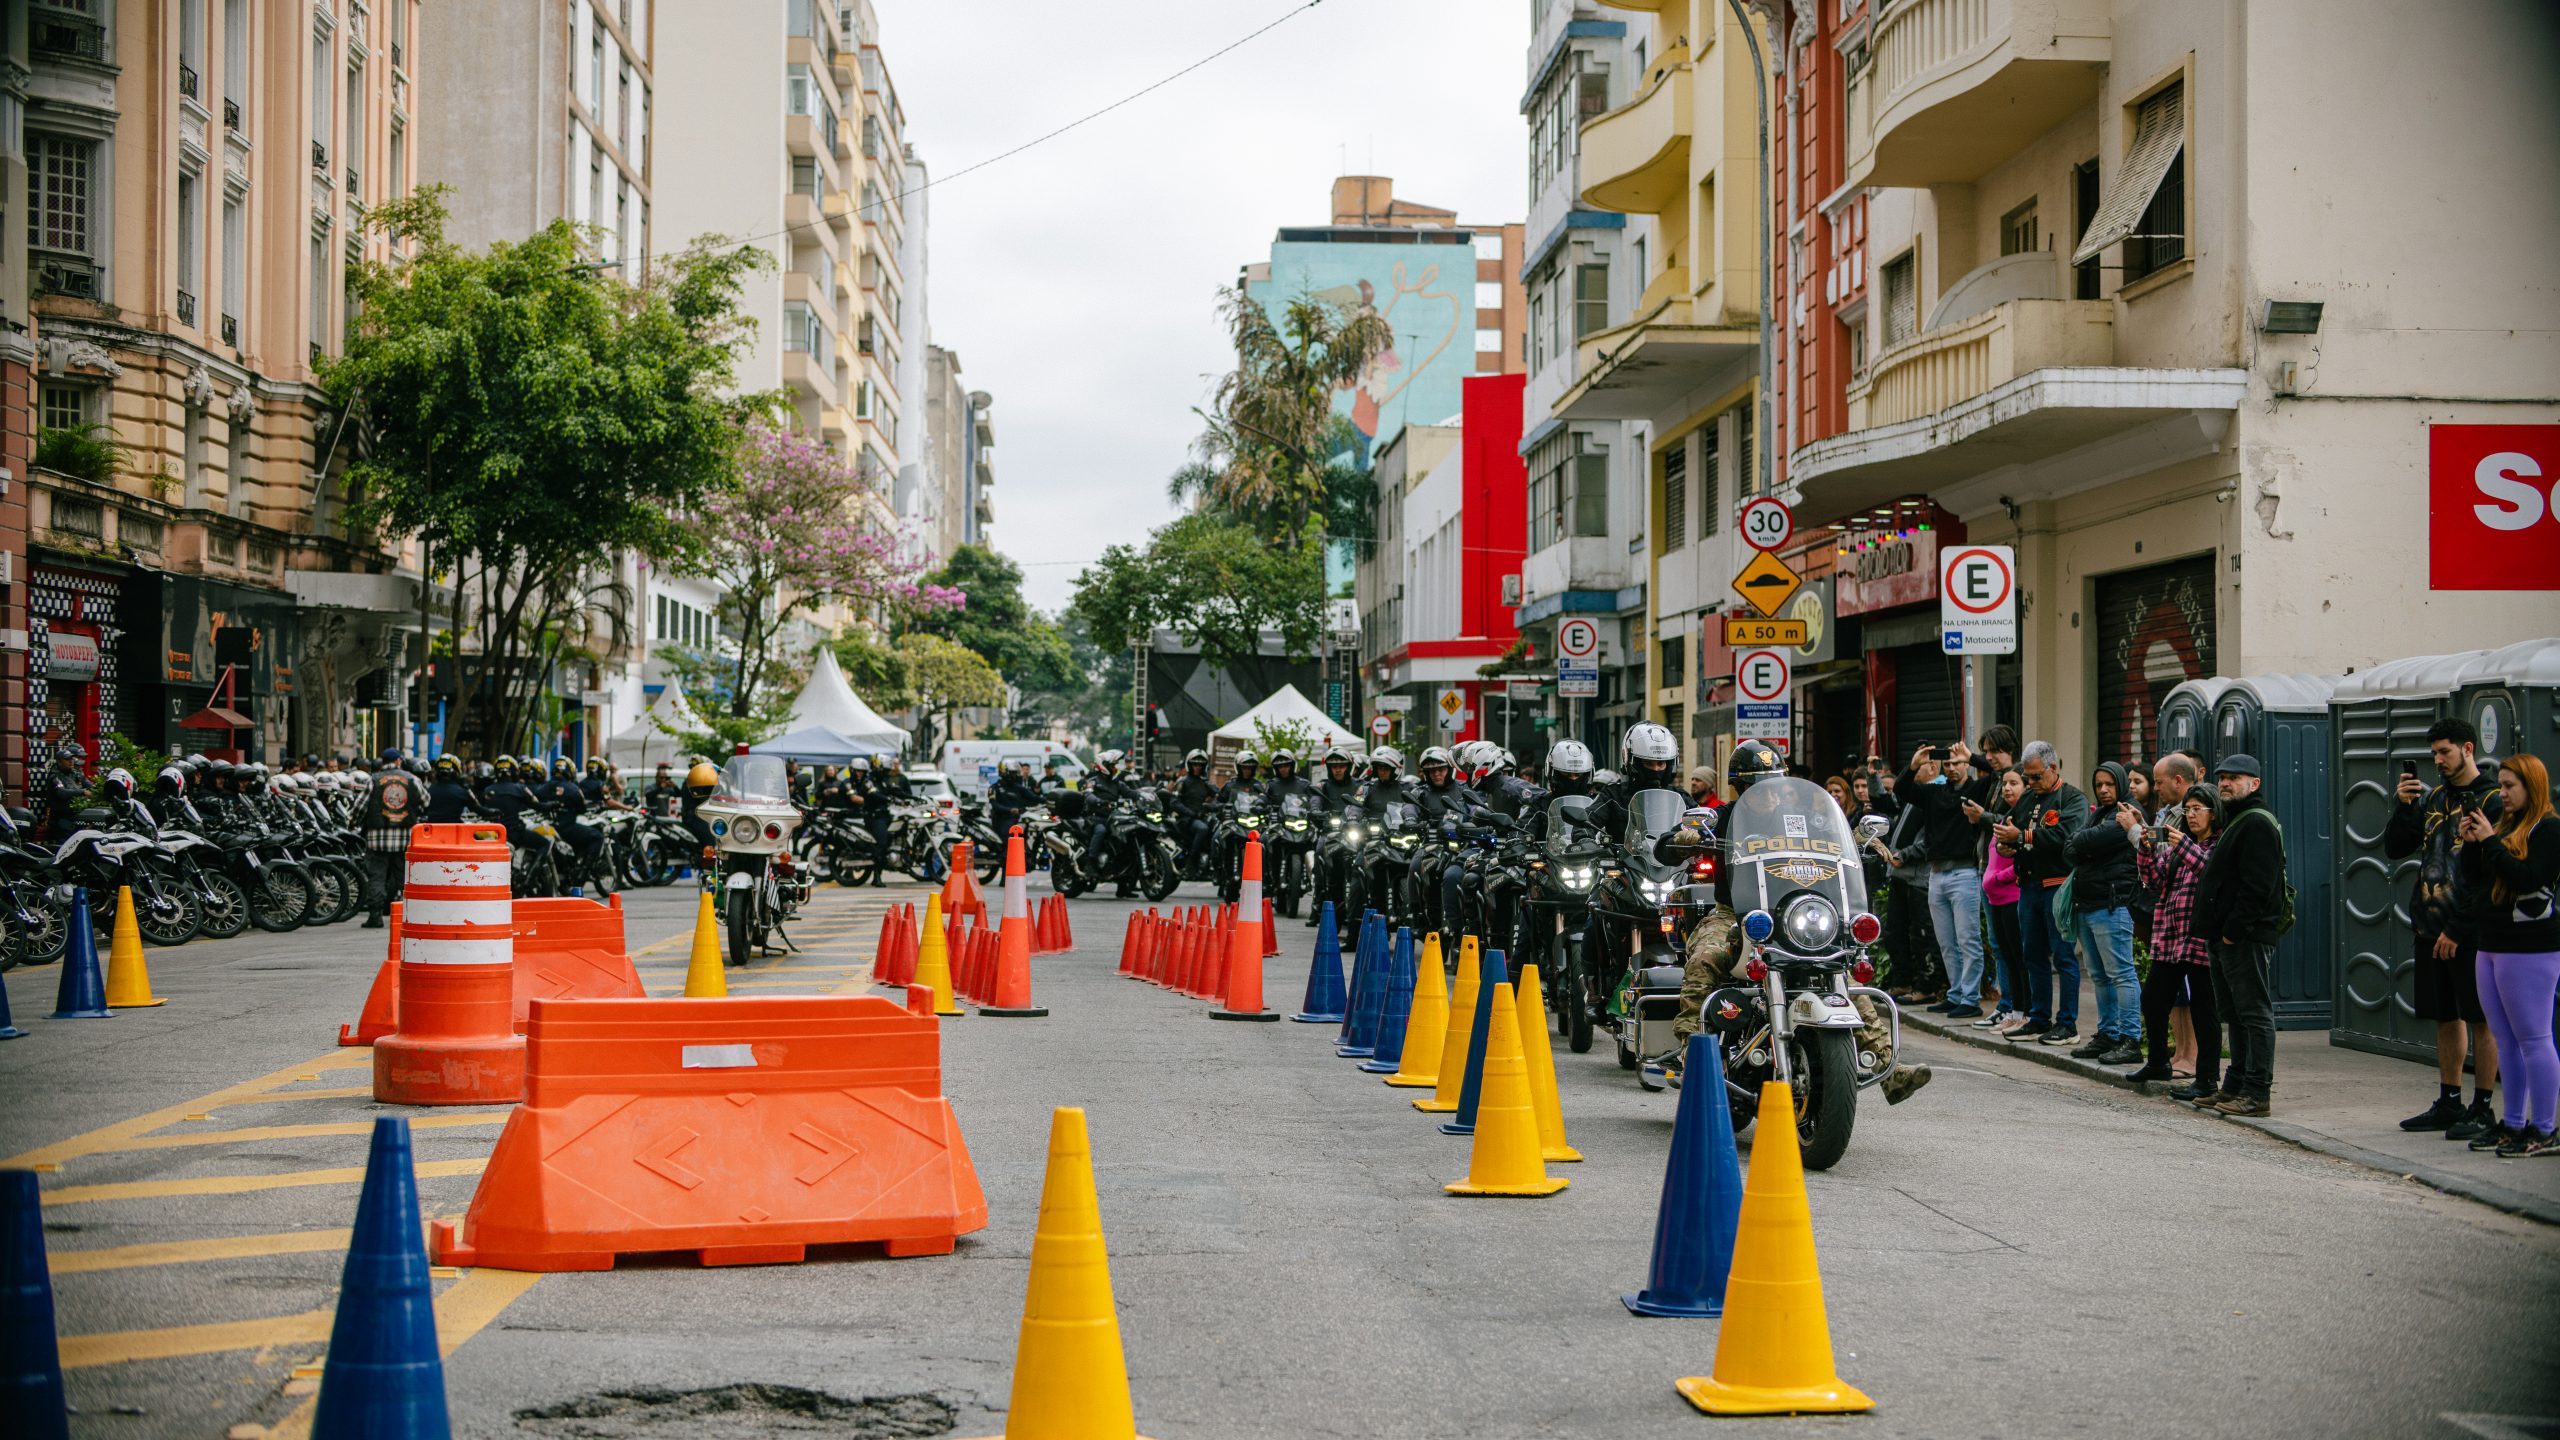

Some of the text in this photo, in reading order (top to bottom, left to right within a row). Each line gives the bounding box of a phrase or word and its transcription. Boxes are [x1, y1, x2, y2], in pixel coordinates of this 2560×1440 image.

[2473, 451, 2560, 531] S
[1750, 510, 1783, 533] 30
[1967, 564, 1989, 599] E
[1572, 629, 1584, 647] E
[1736, 626, 1798, 639] A 50 m
[1965, 636, 2014, 644] Motocicleta
[1754, 663, 1771, 689] E
[1747, 836, 1843, 856] POLICE
